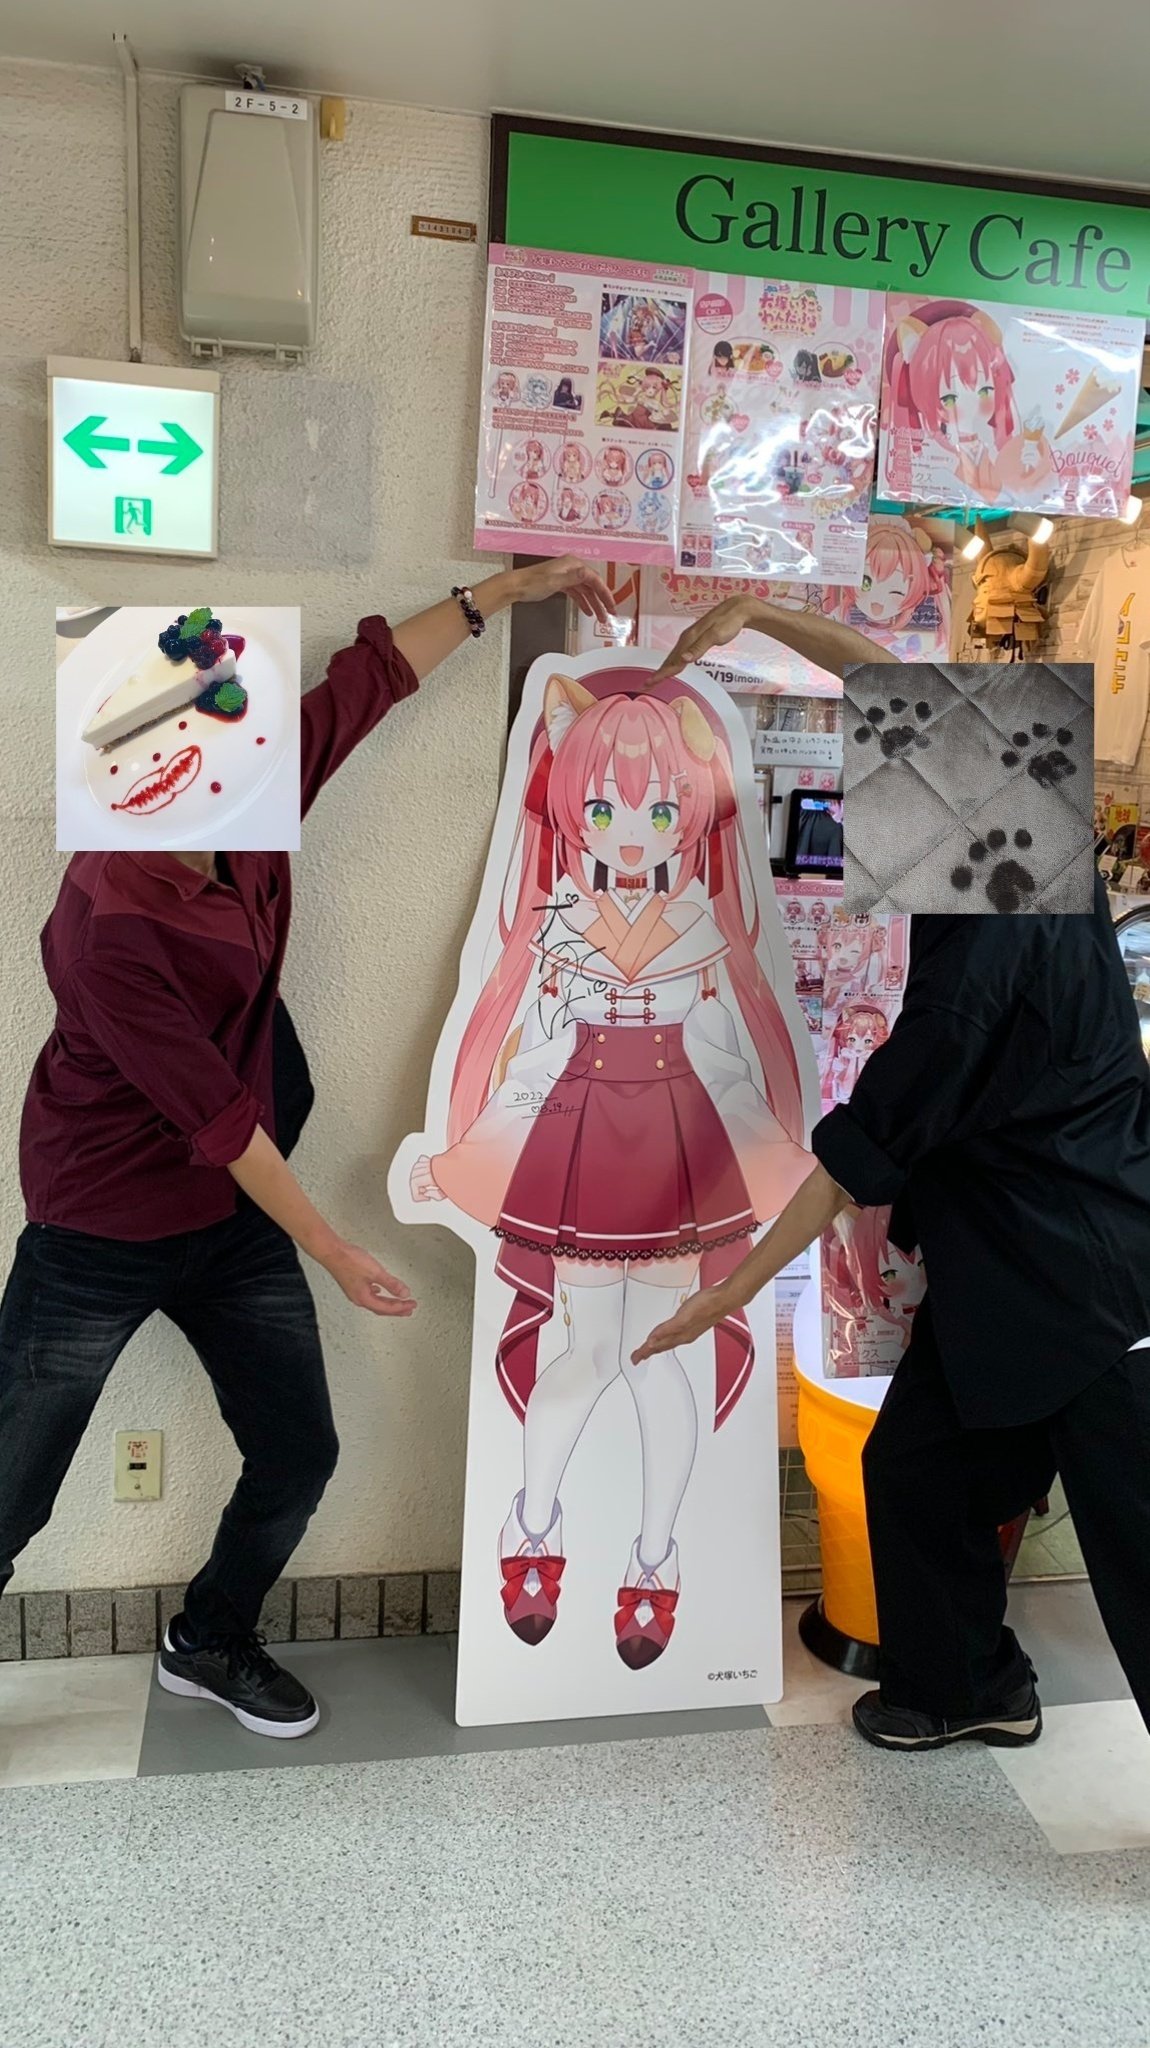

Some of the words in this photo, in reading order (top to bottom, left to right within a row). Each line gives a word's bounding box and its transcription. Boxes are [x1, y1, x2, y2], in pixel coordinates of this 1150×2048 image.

[235, 97, 299, 114] 2F-5-2
[675, 174, 951, 278] Gallery
[969, 214, 1131, 293] Cafe
[1048, 444, 1126, 478] Bouquet
